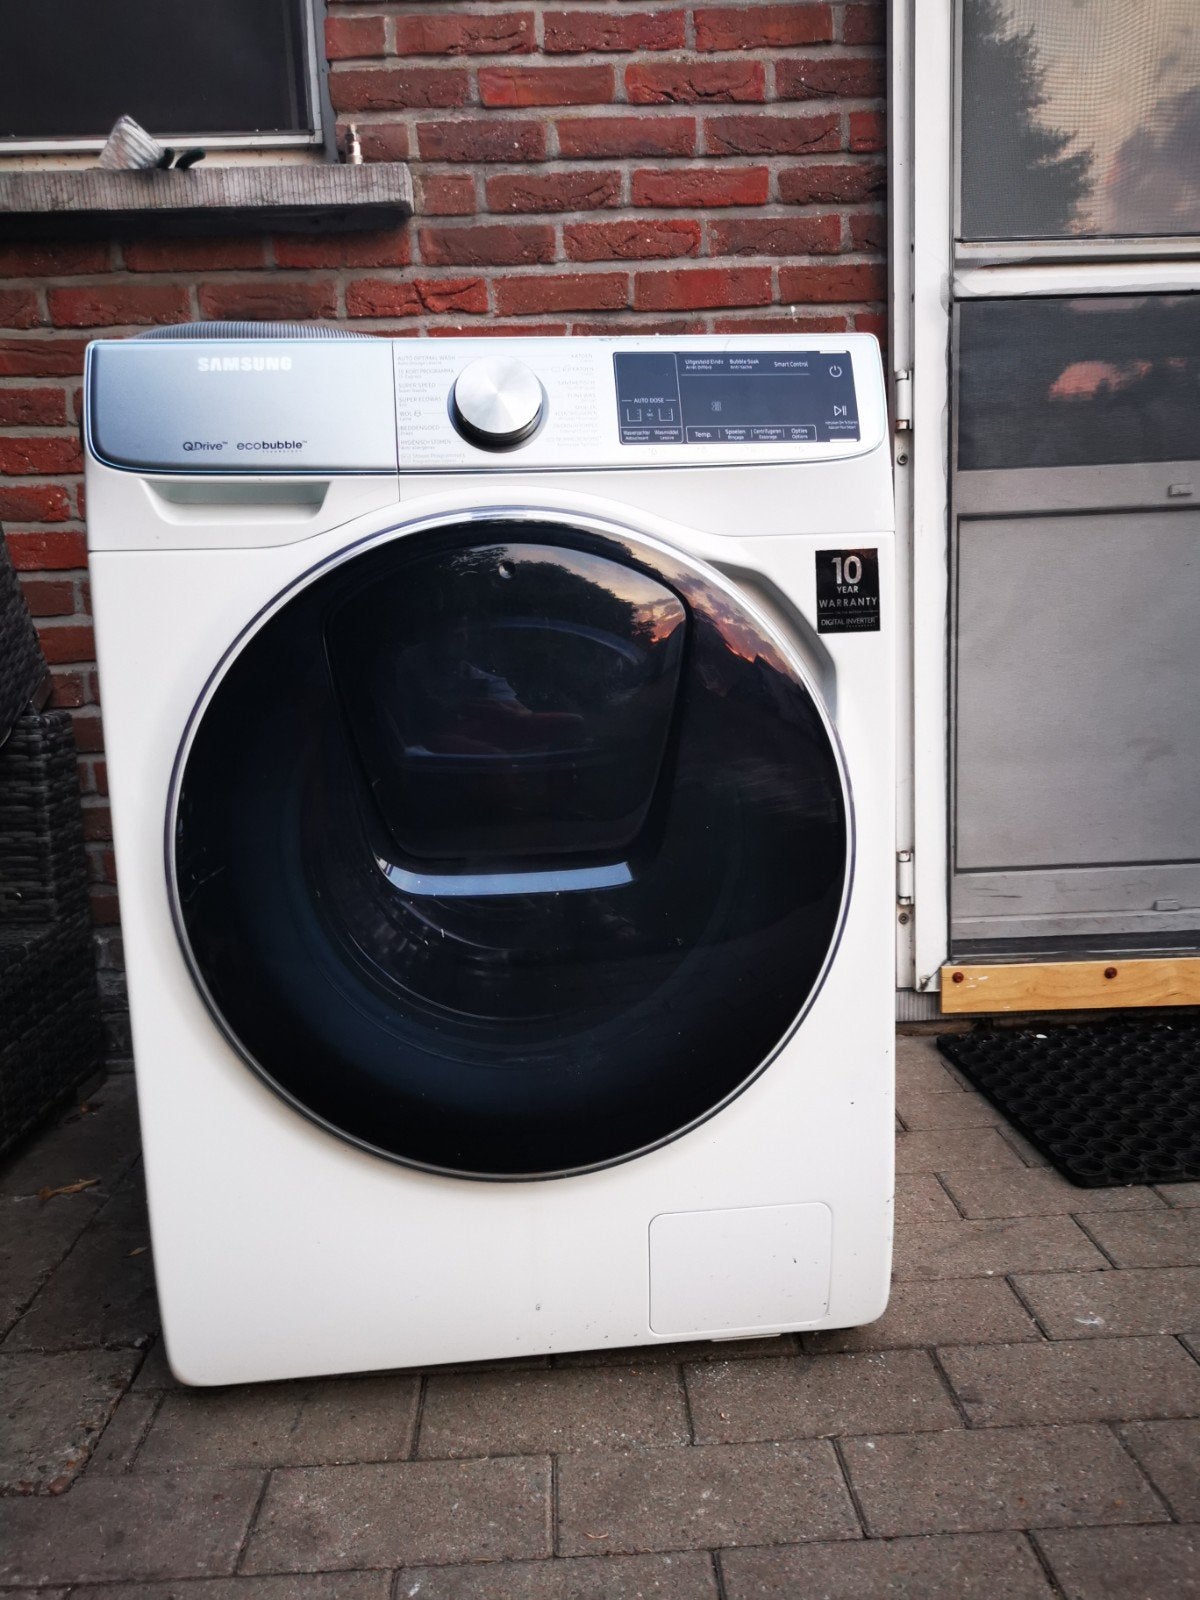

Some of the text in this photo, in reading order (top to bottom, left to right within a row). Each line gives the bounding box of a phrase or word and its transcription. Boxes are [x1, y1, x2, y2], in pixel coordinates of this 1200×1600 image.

[197, 356, 292, 371] SAMSUNG
[831, 555, 863, 584] 10
[836, 585, 859, 594] YEAR
[818, 597, 878, 609] WARRANTY
[821, 618, 845, 626] DIGITAL
